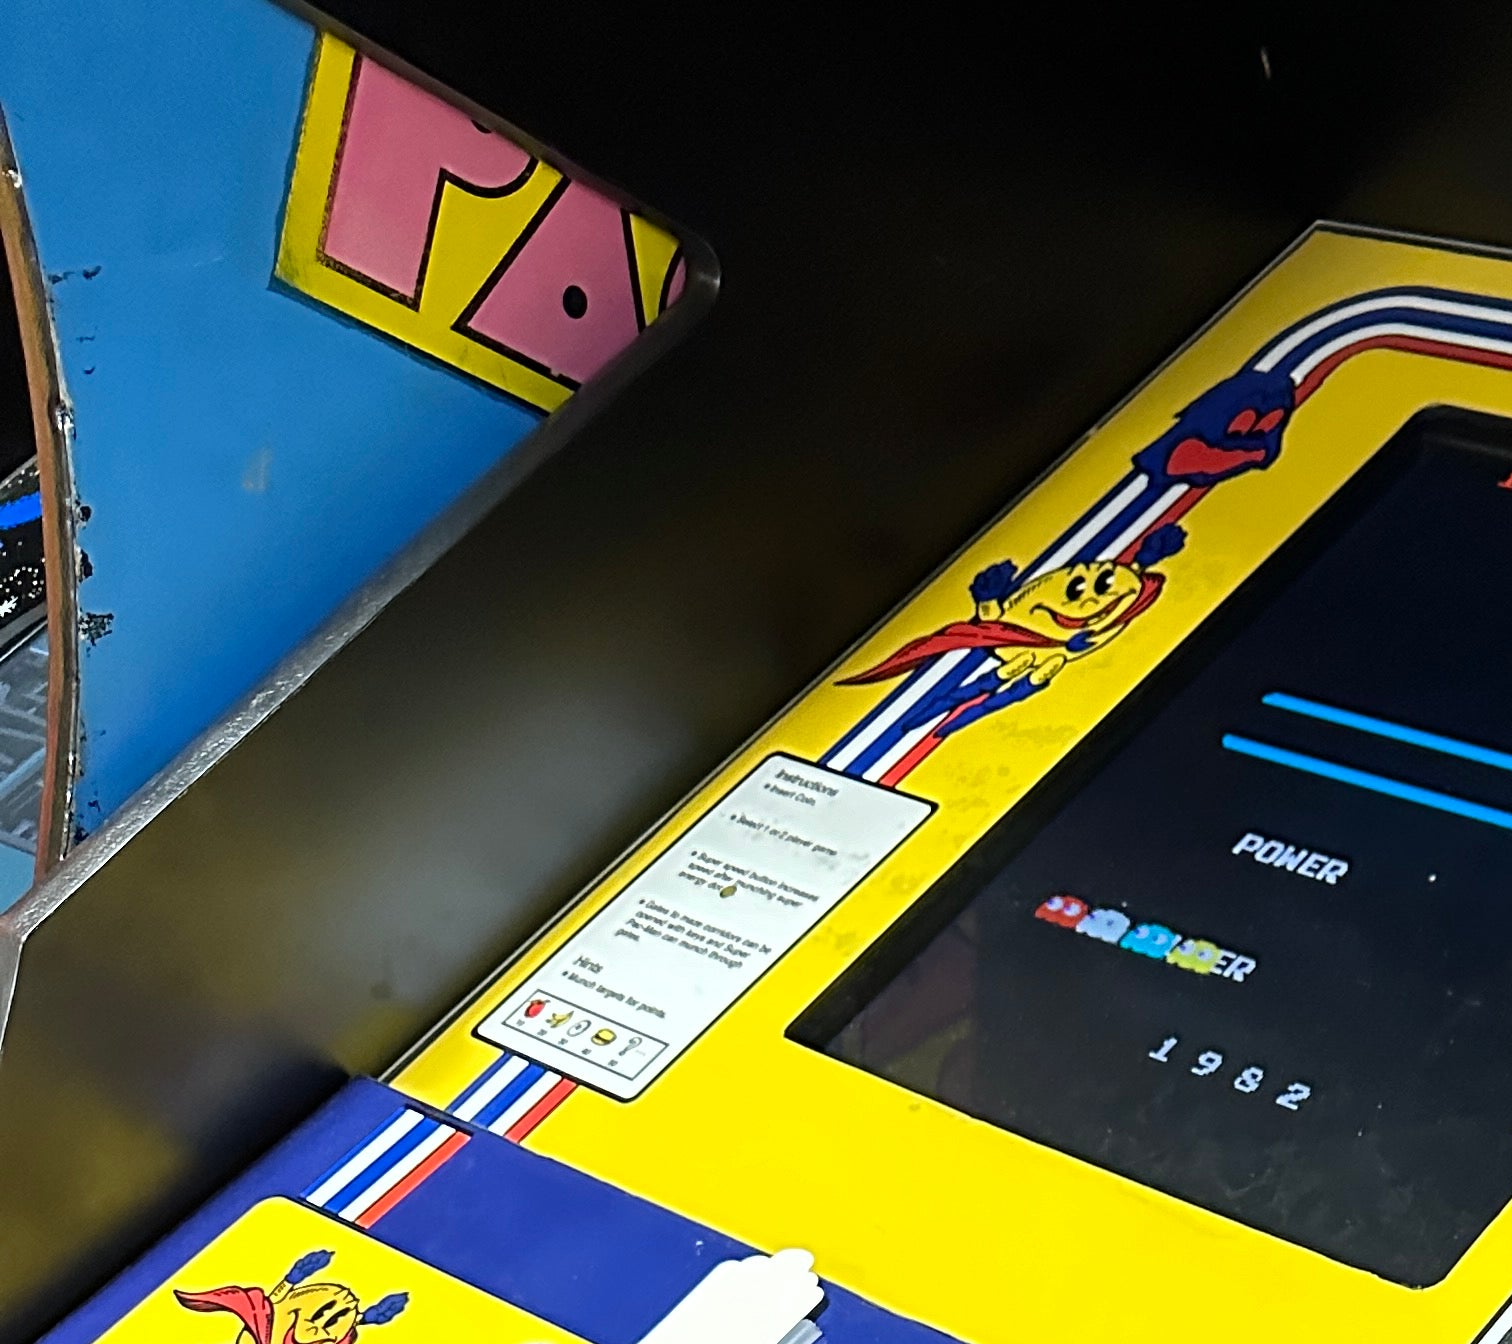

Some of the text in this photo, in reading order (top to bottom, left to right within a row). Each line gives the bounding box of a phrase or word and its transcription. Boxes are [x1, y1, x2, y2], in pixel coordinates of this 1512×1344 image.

[775, 769, 839, 797] Instructions
[1231, 832, 1349, 885] POWER
[572, 955, 604, 974] Hints
